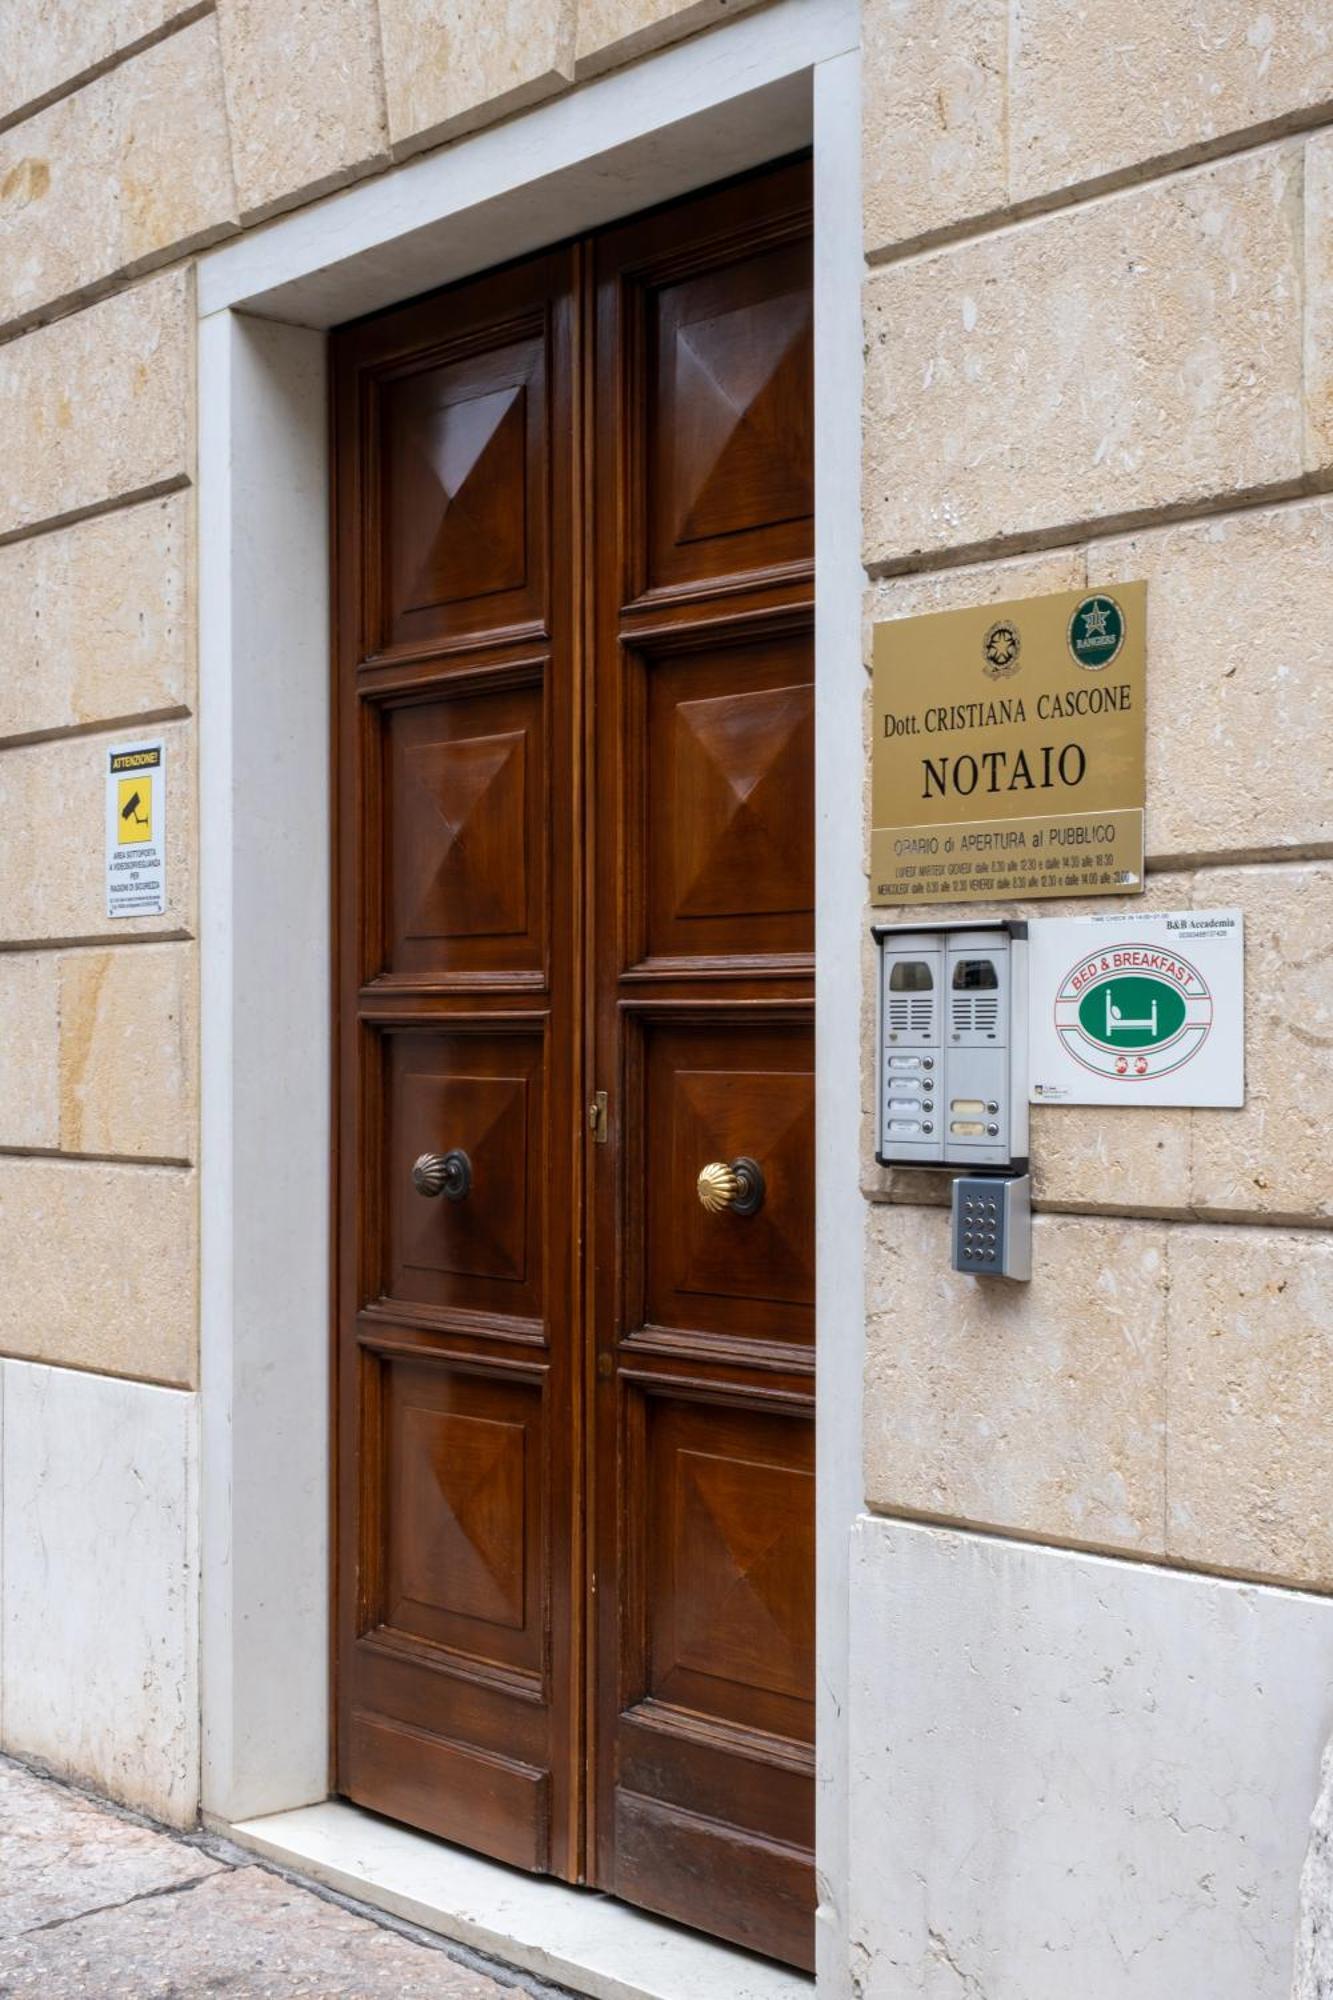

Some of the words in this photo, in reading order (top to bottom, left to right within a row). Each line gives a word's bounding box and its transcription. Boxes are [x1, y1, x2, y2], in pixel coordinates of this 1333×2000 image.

[884, 714, 920, 738] Dott.
[924, 699, 1026, 733] CRISTIANA
[1037, 684, 1132, 720] CASCONE
[113, 752, 158, 769] ATTENZIONE!
[922, 744, 1086, 799] NOTAIO
[894, 837, 939, 856] ORARIO
[944, 837, 954, 853] di
[961, 832, 1026, 851] APERTURA
[1032, 830, 1043, 848] al
[1049, 824, 1115, 846] PUBBLICO
[1166, 920, 1188, 930] B&B
[1189, 918, 1235, 929] Accademia
[1071, 963, 1098, 991] BED
[1100, 957, 1110, 972] &
[1113, 952, 1195, 987] BREAKFAST
